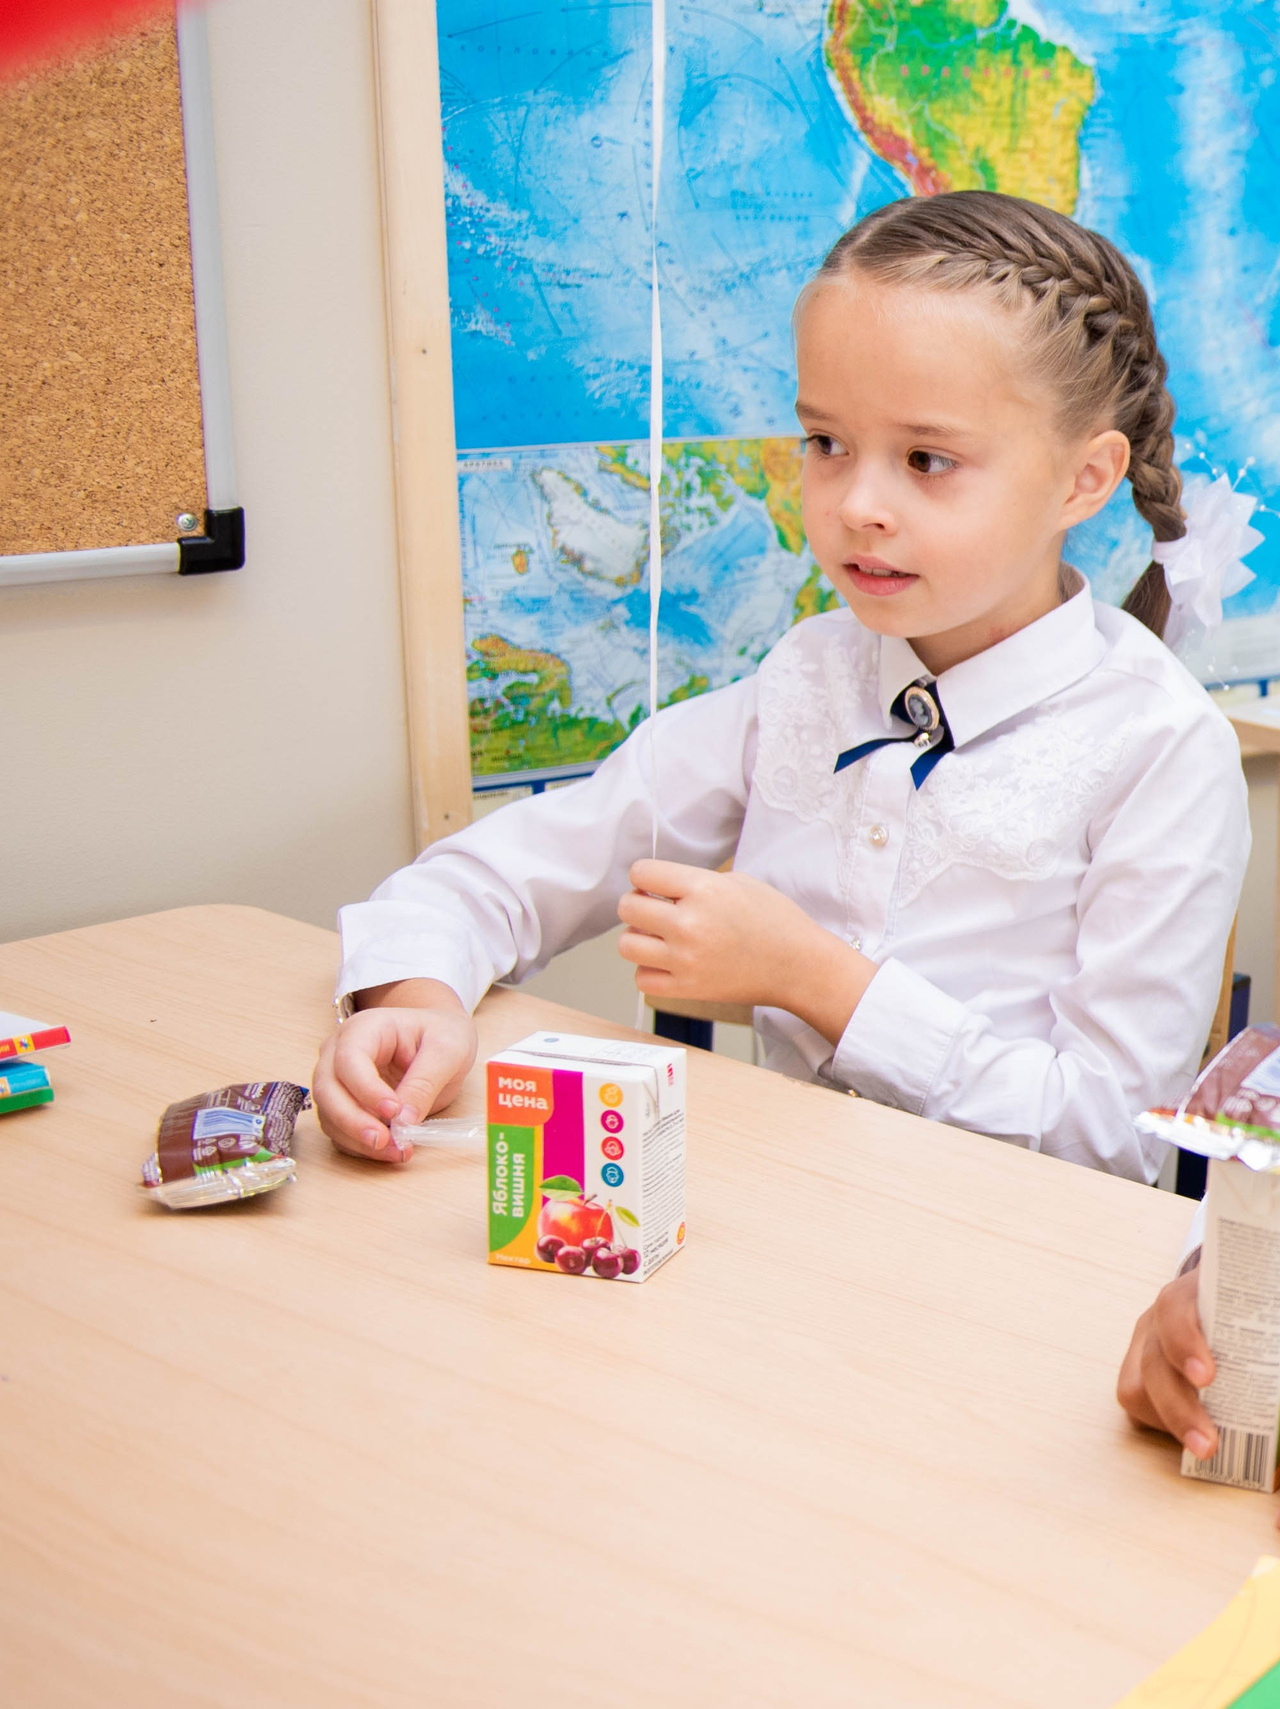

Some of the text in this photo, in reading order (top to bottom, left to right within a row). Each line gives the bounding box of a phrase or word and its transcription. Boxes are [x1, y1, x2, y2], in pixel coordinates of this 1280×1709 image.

[498, 1076, 537, 1093] моя
[498, 1093, 549, 1111] цена
[491, 1132, 509, 1217] Яблоко-
[511, 1153, 525, 1218] вишня
